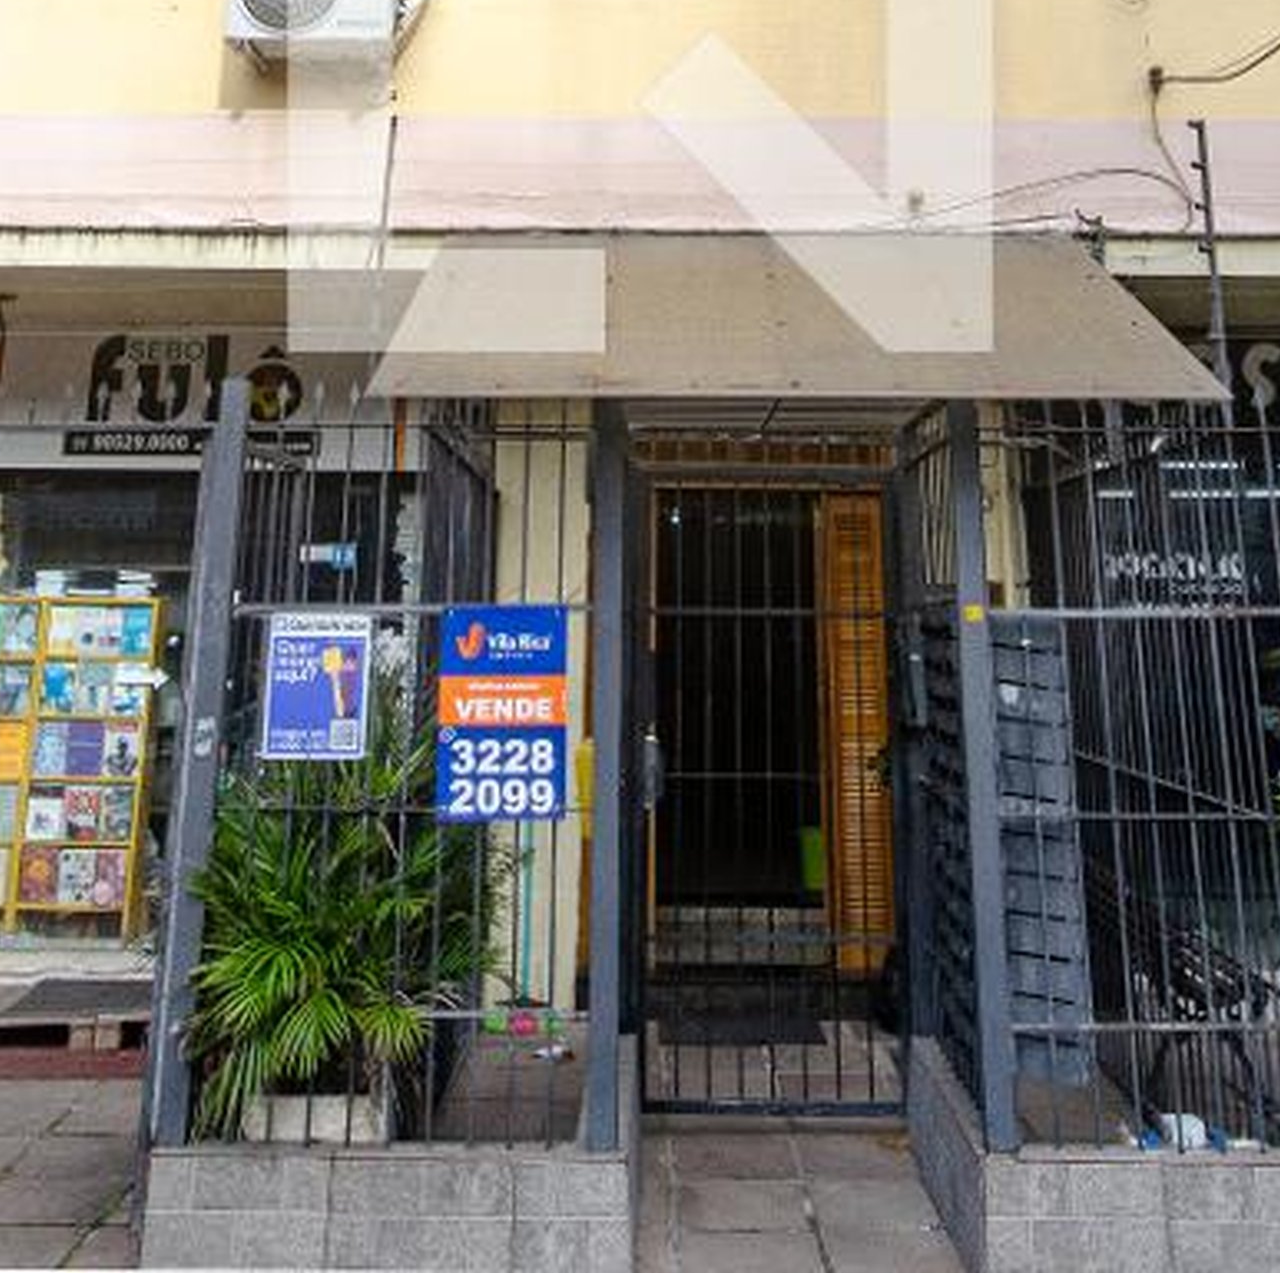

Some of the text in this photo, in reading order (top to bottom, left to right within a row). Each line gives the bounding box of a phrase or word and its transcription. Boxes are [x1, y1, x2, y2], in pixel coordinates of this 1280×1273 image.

[126, 339, 206, 361] SEBO
[455, 698, 554, 720] VENDE
[450, 738, 555, 775] 3228
[448, 778, 556, 815] 2099
